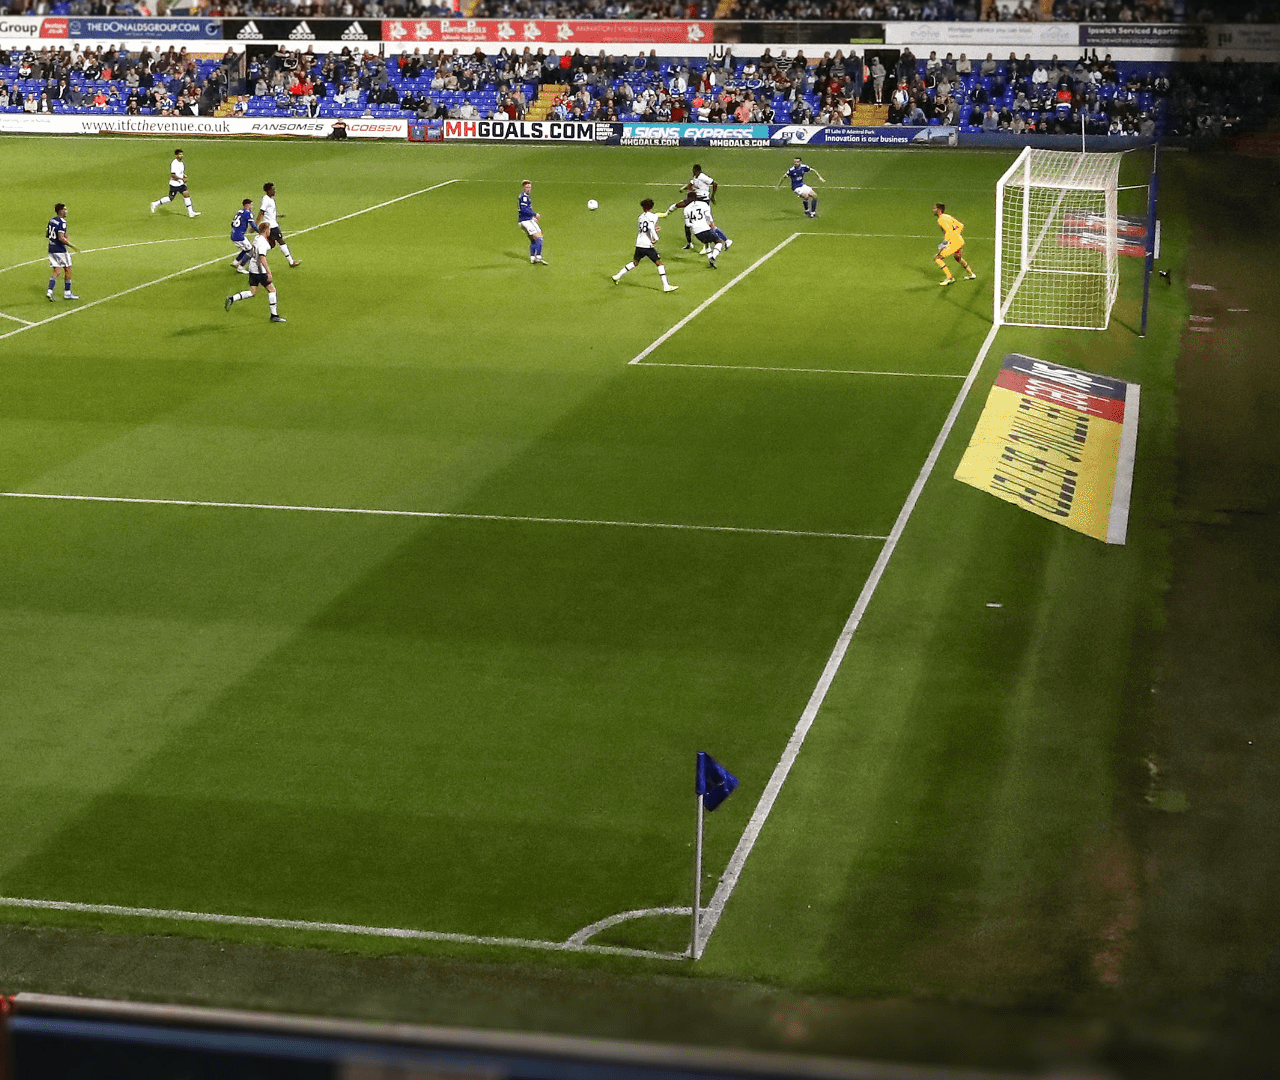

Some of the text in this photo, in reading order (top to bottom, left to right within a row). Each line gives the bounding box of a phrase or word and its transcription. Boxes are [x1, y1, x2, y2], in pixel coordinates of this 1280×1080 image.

[0, 21, 37, 36] Group
[1088, 27, 1116, 36] Ipswich
[1118, 27, 1150, 35] Serviced
[82, 120, 230, 133] www.itfcthevenue.co.uk
[446, 122, 593, 140] MHGOALS.COM
[635, 127, 754, 138] SIGNS EXPRESS
[710, 139, 770, 147] MHGOALS.COM
[825, 134, 860, 142] Innovation
[880, 135, 908, 143] business
[1024, 378, 1110, 414] bet
[991, 398, 1089, 517] BETTING BETTER
